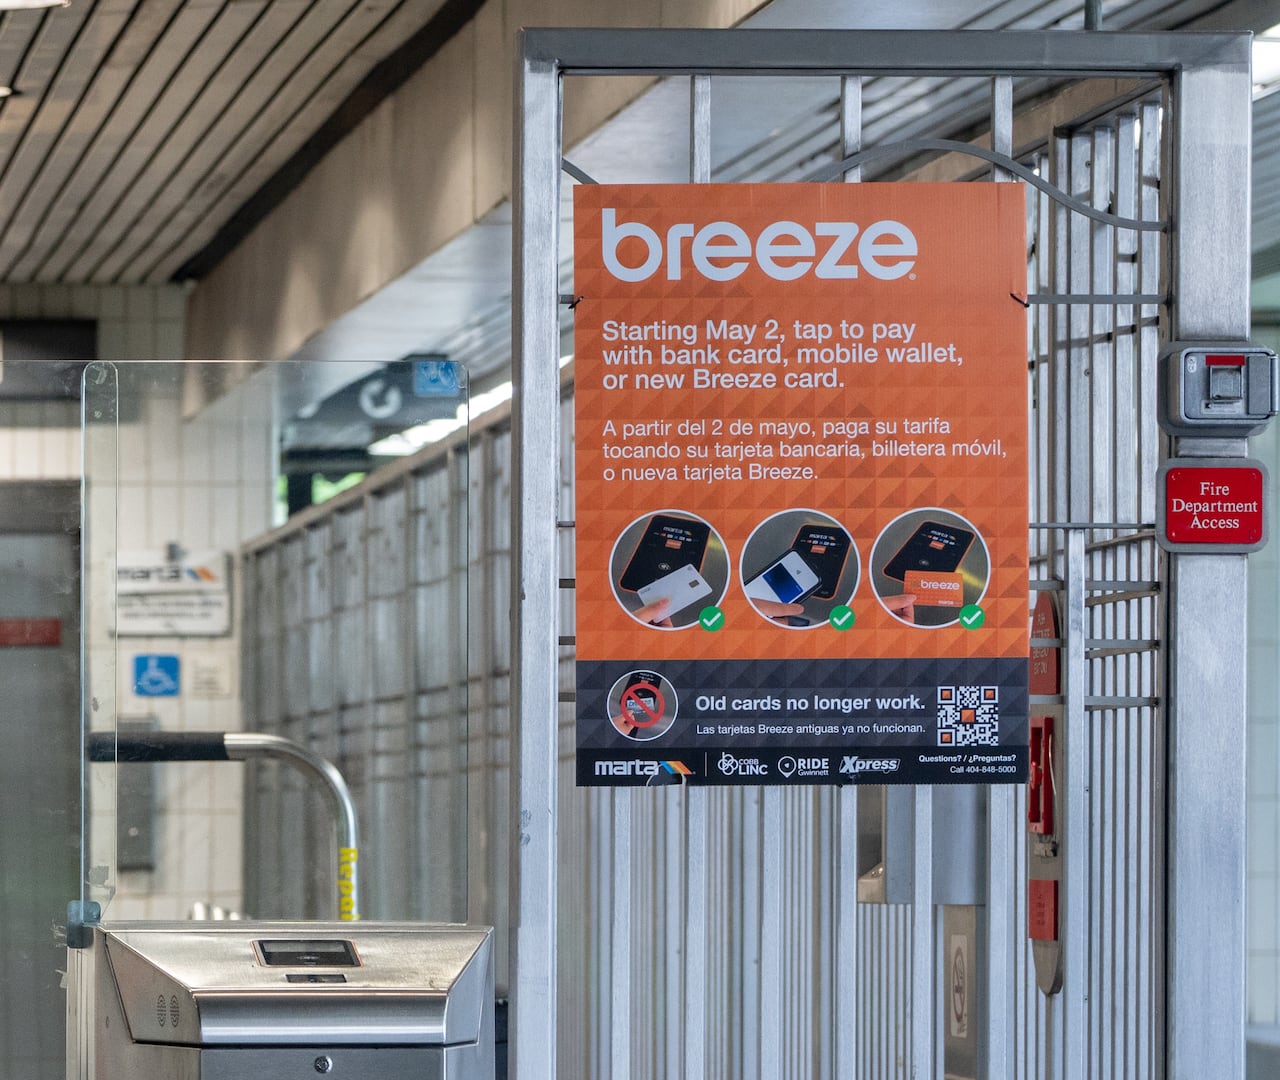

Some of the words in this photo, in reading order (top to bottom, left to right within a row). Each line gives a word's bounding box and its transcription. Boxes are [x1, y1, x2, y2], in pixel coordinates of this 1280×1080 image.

[601, 207, 918, 282] breeze
[602, 320, 698, 344] Starting
[706, 319, 757, 344] May
[764, 320, 785, 344] 2,
[793, 321, 833, 344] tap
[840, 321, 865, 340] to
[872, 322, 916, 344] pay
[602, 343, 653, 365] with
[661, 342, 721, 365] bank
[727, 342, 789, 368] card,
[797, 341, 879, 364] mobile
[885, 341, 963, 367] wallet,
[602, 373, 629, 390] or
[635, 373, 685, 390] new
[693, 368, 777, 389] Breeze
[784, 367, 845, 389] card.
[602, 419, 617, 437] A
[622, 419, 673, 440] partir
[677, 419, 706, 436] del
[711, 419, 723, 436] 2
[729, 418, 753, 436] de
[759, 422, 816, 439] mayo,
[822, 421, 870, 439] paga
[875, 421, 897, 435] su
[902, 417, 951, 435] tarifa
[602, 440, 681, 459] tocando
[686, 445, 709, 458] su
[714, 441, 774, 462] tarjeta
[779, 440, 865, 460] bancaria,
[872, 439, 947, 457] billetera
[951, 438, 1007, 459] móvil,
[602, 468, 616, 481] o
[621, 467, 678, 481] nueva
[682, 463, 743, 484] tarjeta
[748, 462, 819, 480] Breeze.
[1200, 481, 1230, 496] Fire
[1172, 498, 1258, 516] Department
[1190, 515, 1240, 529] Access
[920, 580, 960, 591] breeze
[695, 695, 728, 712] Old
[731, 695, 783, 711] cards
[786, 698, 809, 711] no
[814, 694, 872, 715] longer
[875, 694, 926, 711] work.
[696, 724, 716, 735] Las
[717, 724, 756, 737] tarjetas
[758, 723, 794, 735] Breeze
[795, 723, 840, 736] antiguas
[841, 725, 855, 736] ya
[856, 725, 871, 734] no
[872, 722, 926, 733] funcionan.
[594, 759, 659, 776] marta
[738, 758, 760, 766] COBB
[797, 757, 830, 769] RIDE
[839, 756, 898, 773] Xpress
[918, 754, 962, 763] Questions?
[963, 754, 968, 763] /
[968, 754, 1017, 764] ¿Preguntas?
[738, 764, 769, 776] LINC
[797, 768, 830, 777] Gwinnett
[949, 765, 964, 774] Call
[965, 765, 1017, 774] 404-848-5000
